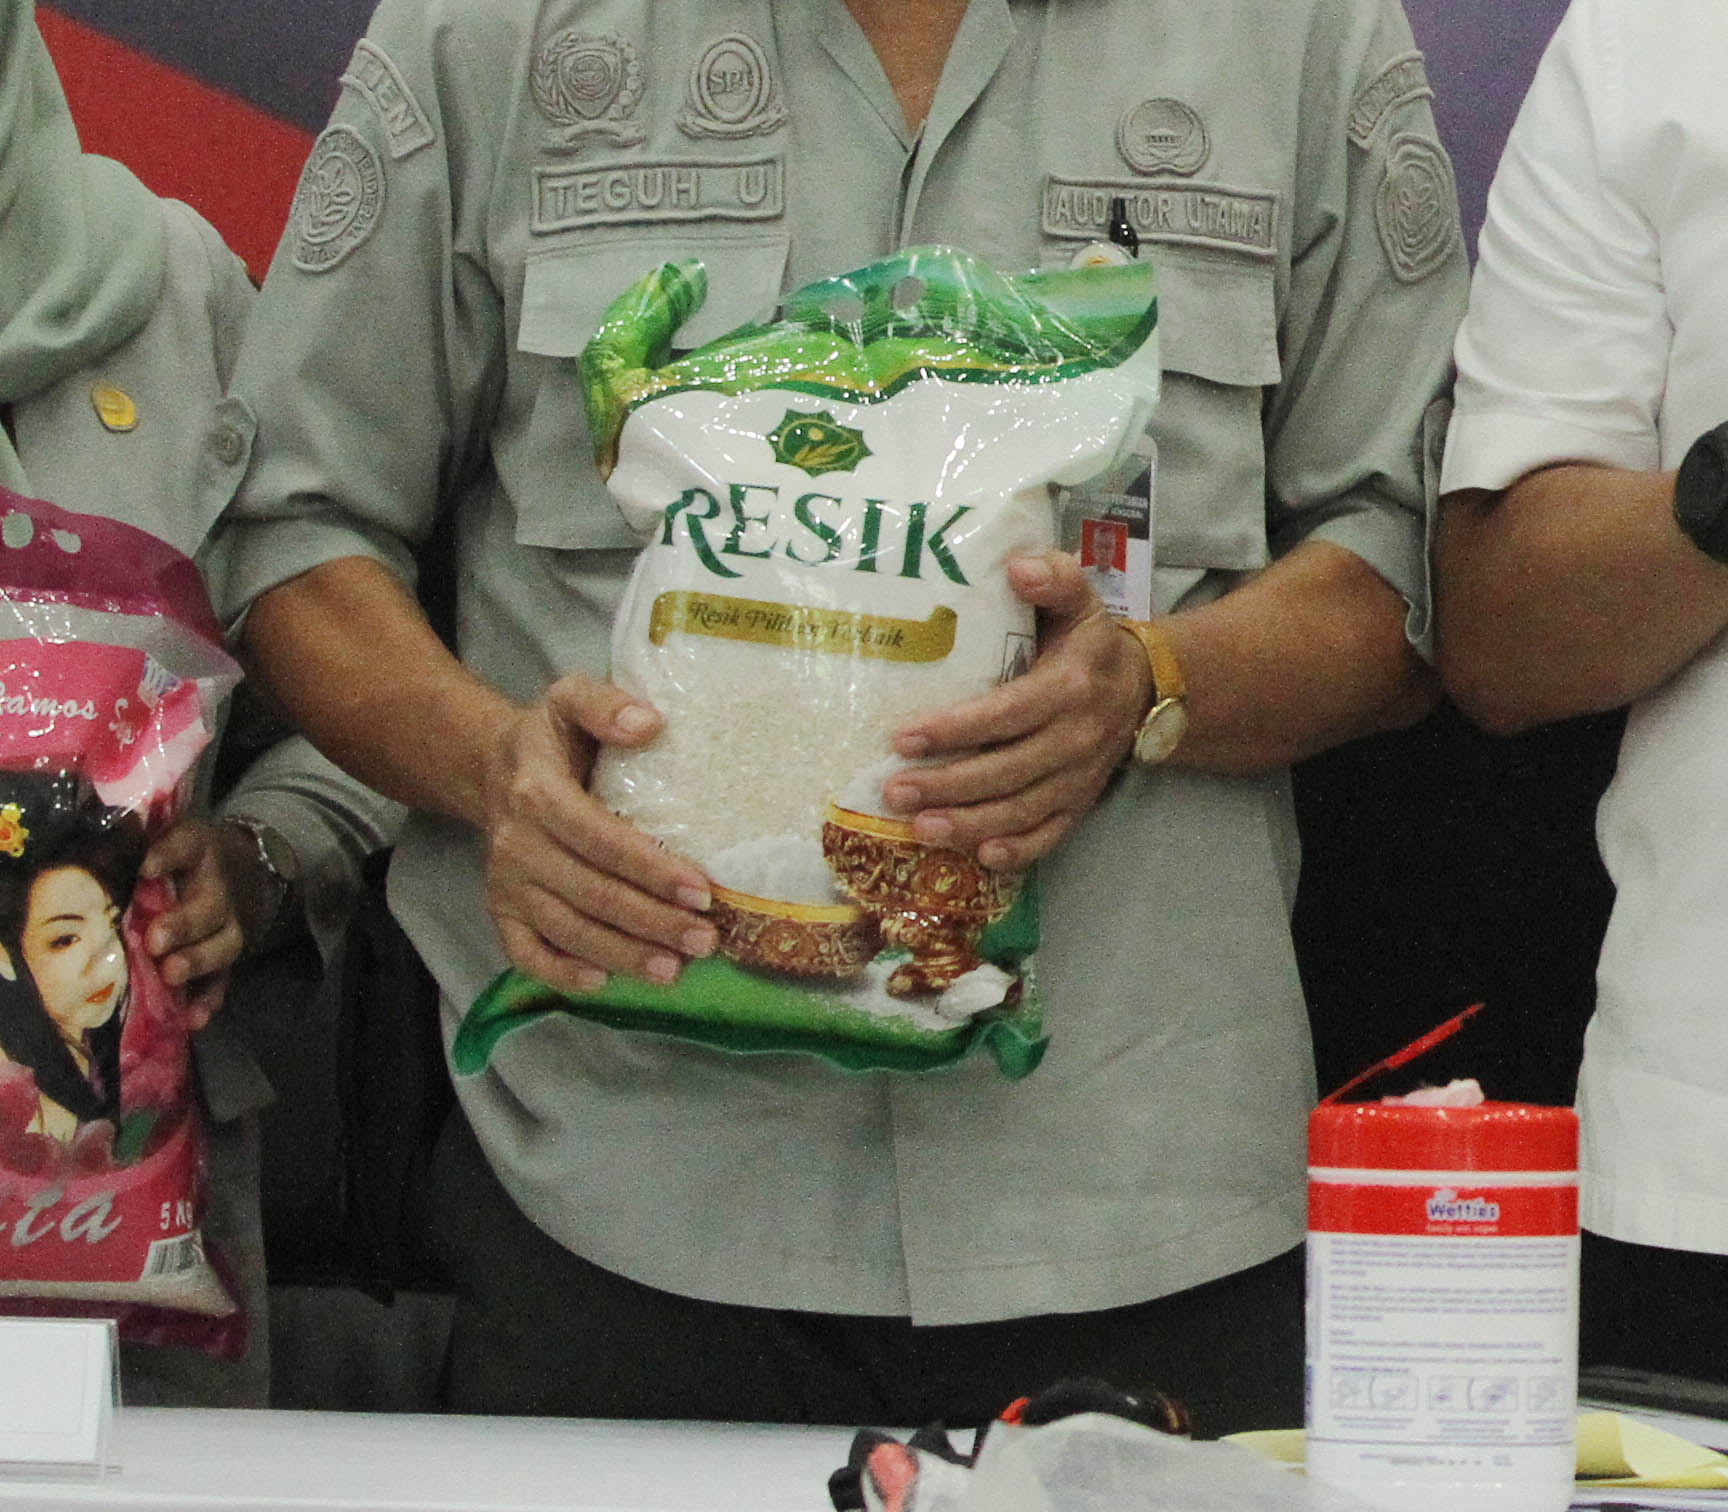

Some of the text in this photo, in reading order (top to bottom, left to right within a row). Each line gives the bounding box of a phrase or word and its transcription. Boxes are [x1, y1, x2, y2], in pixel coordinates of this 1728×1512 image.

[550, 166, 768, 217] TEGUH U
[1056, 189, 1265, 237] AUDTOR UTAMA
[660, 484, 976, 586] RESIK
[160, 1201, 172, 1231] 5
